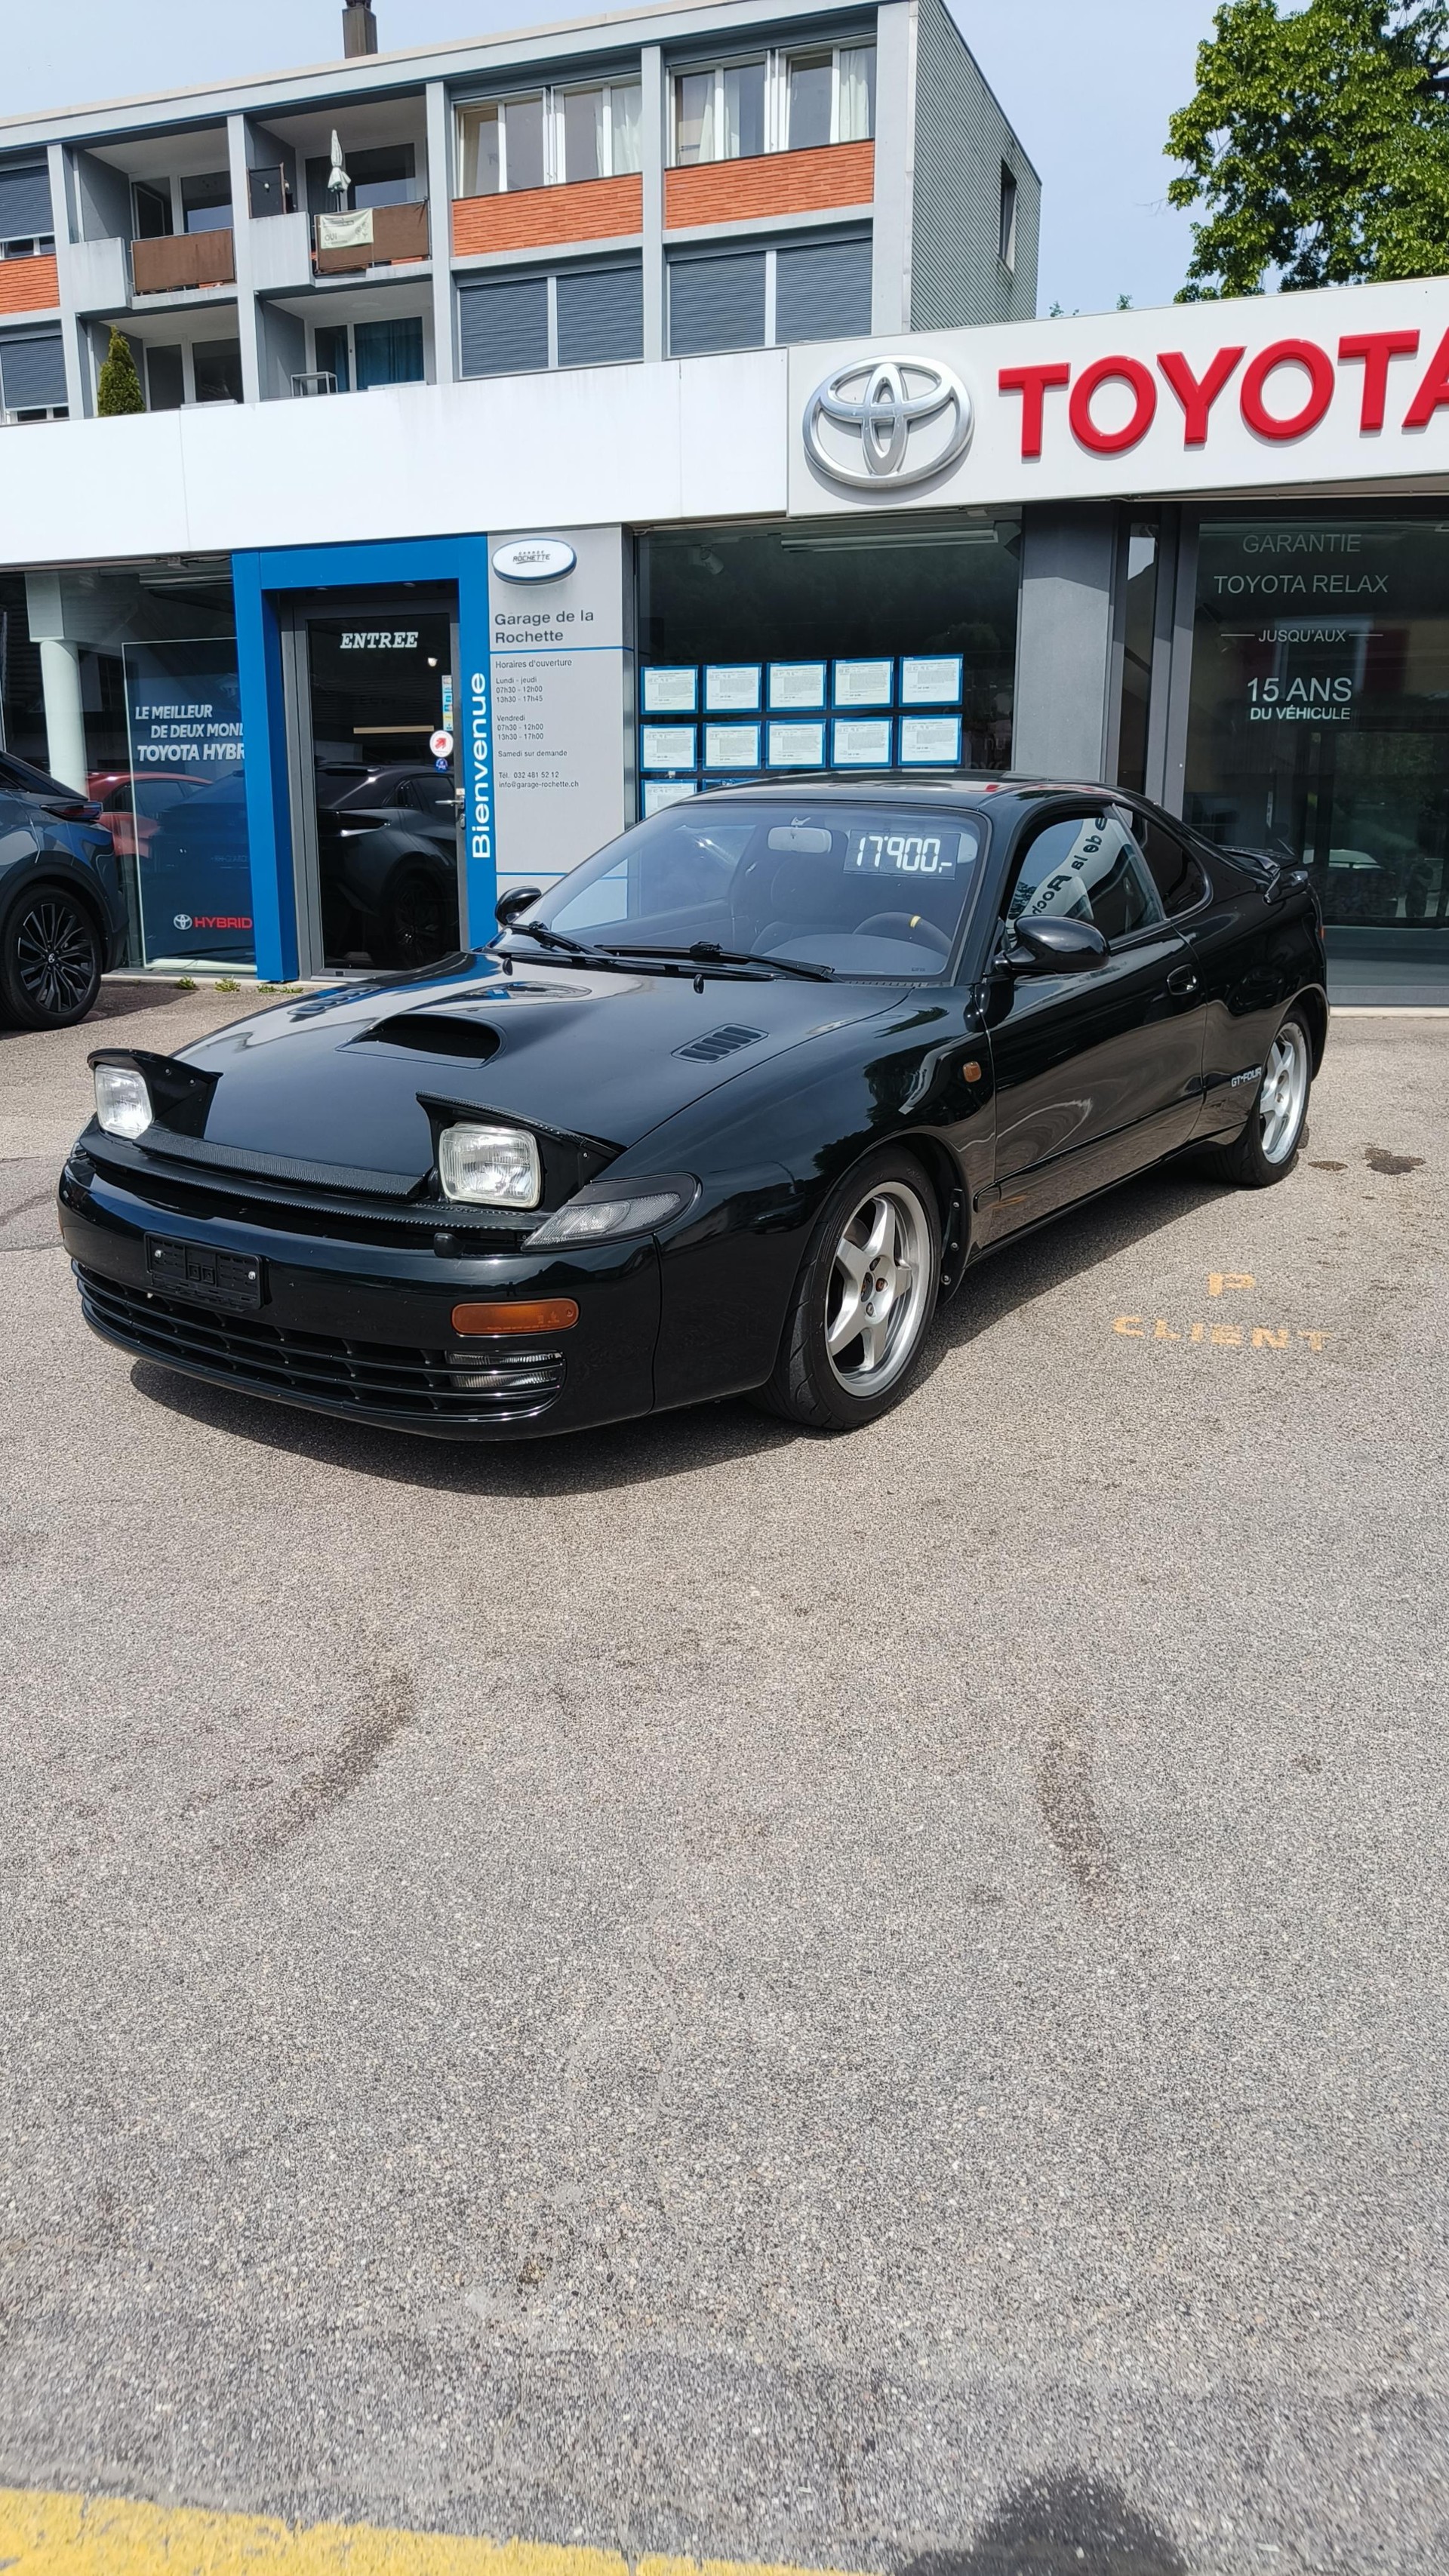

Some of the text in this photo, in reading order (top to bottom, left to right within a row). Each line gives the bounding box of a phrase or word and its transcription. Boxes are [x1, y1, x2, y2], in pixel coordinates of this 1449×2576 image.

[1243, 534, 1361, 553] GARANTIE
[512, 554, 551, 562] ROCHETTE
[1214, 575, 1389, 594] TOYOTA RELAX
[494, 610, 594, 626] Garage de la
[340, 632, 419, 649] ENTREE
[495, 630, 564, 644] Rochette
[1258, 629, 1346, 642] JUSQU'AUX
[495, 660, 527, 669] Horaires
[521, 676, 537, 685] jeudi
[1247, 677, 1352, 702] 15 ANS
[135, 704, 212, 719] LE MEILLEUR
[1251, 704, 1351, 720] DU VÉHICULE
[151, 725, 168, 738] DE
[170, 724, 205, 738] DEUX
[137, 744, 200, 762] TOYOTA
[536, 749, 568, 757] demande
[471, 672, 491, 858] Bienvenue
[194, 916, 253, 929] HYBRID
[1231, 1066, 1262, 1088] GT-FOUR
[1208, 1273, 1256, 1297] P
[1112, 1316, 1331, 1352] CLIENT
